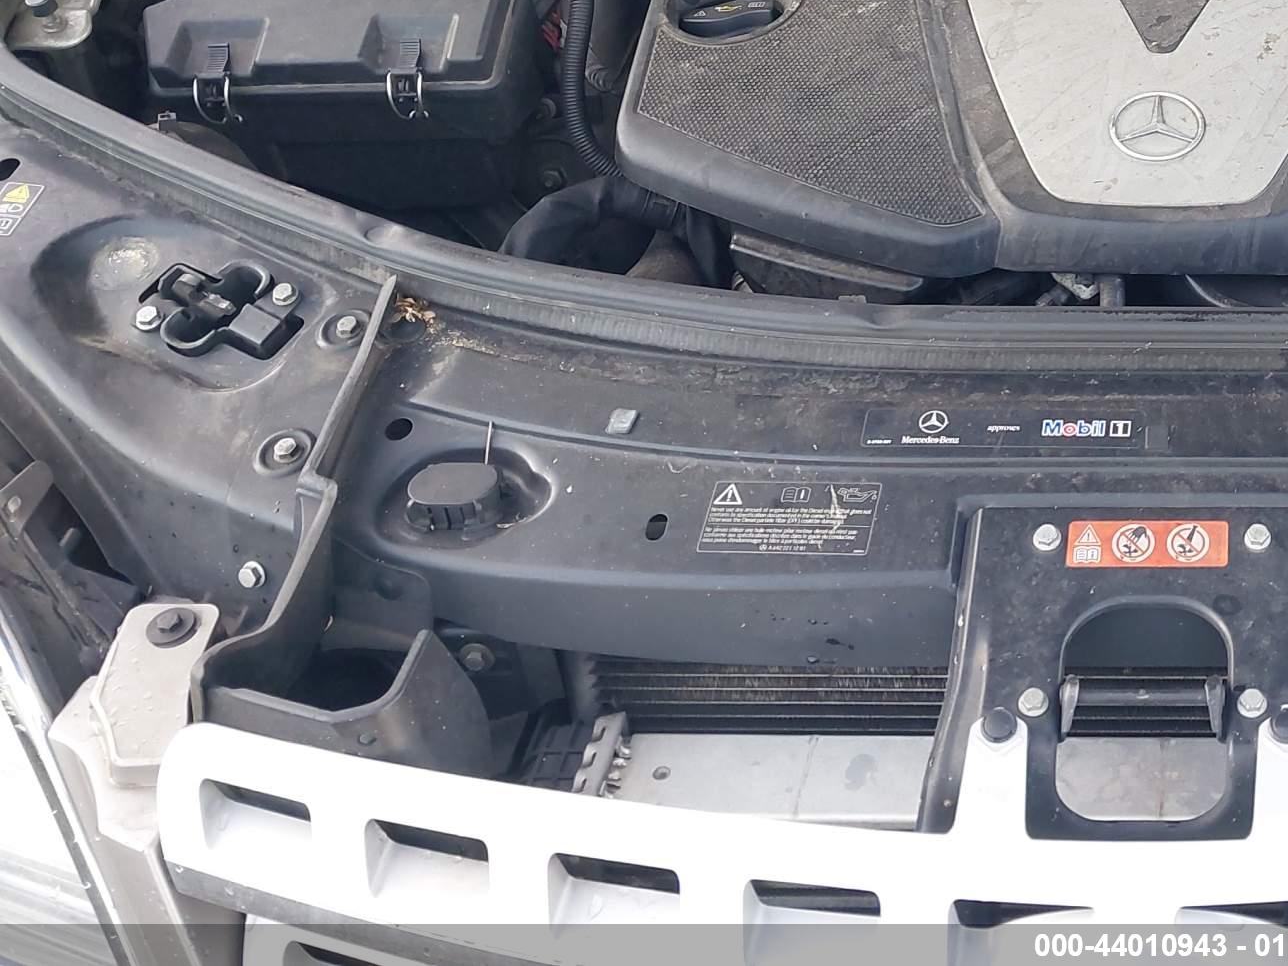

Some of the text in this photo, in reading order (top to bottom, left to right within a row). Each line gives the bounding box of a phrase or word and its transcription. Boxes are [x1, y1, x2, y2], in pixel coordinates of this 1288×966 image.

[1041, 419, 1130, 437] Mobil 1
[901, 435, 960, 444] Mercedes-Benz
